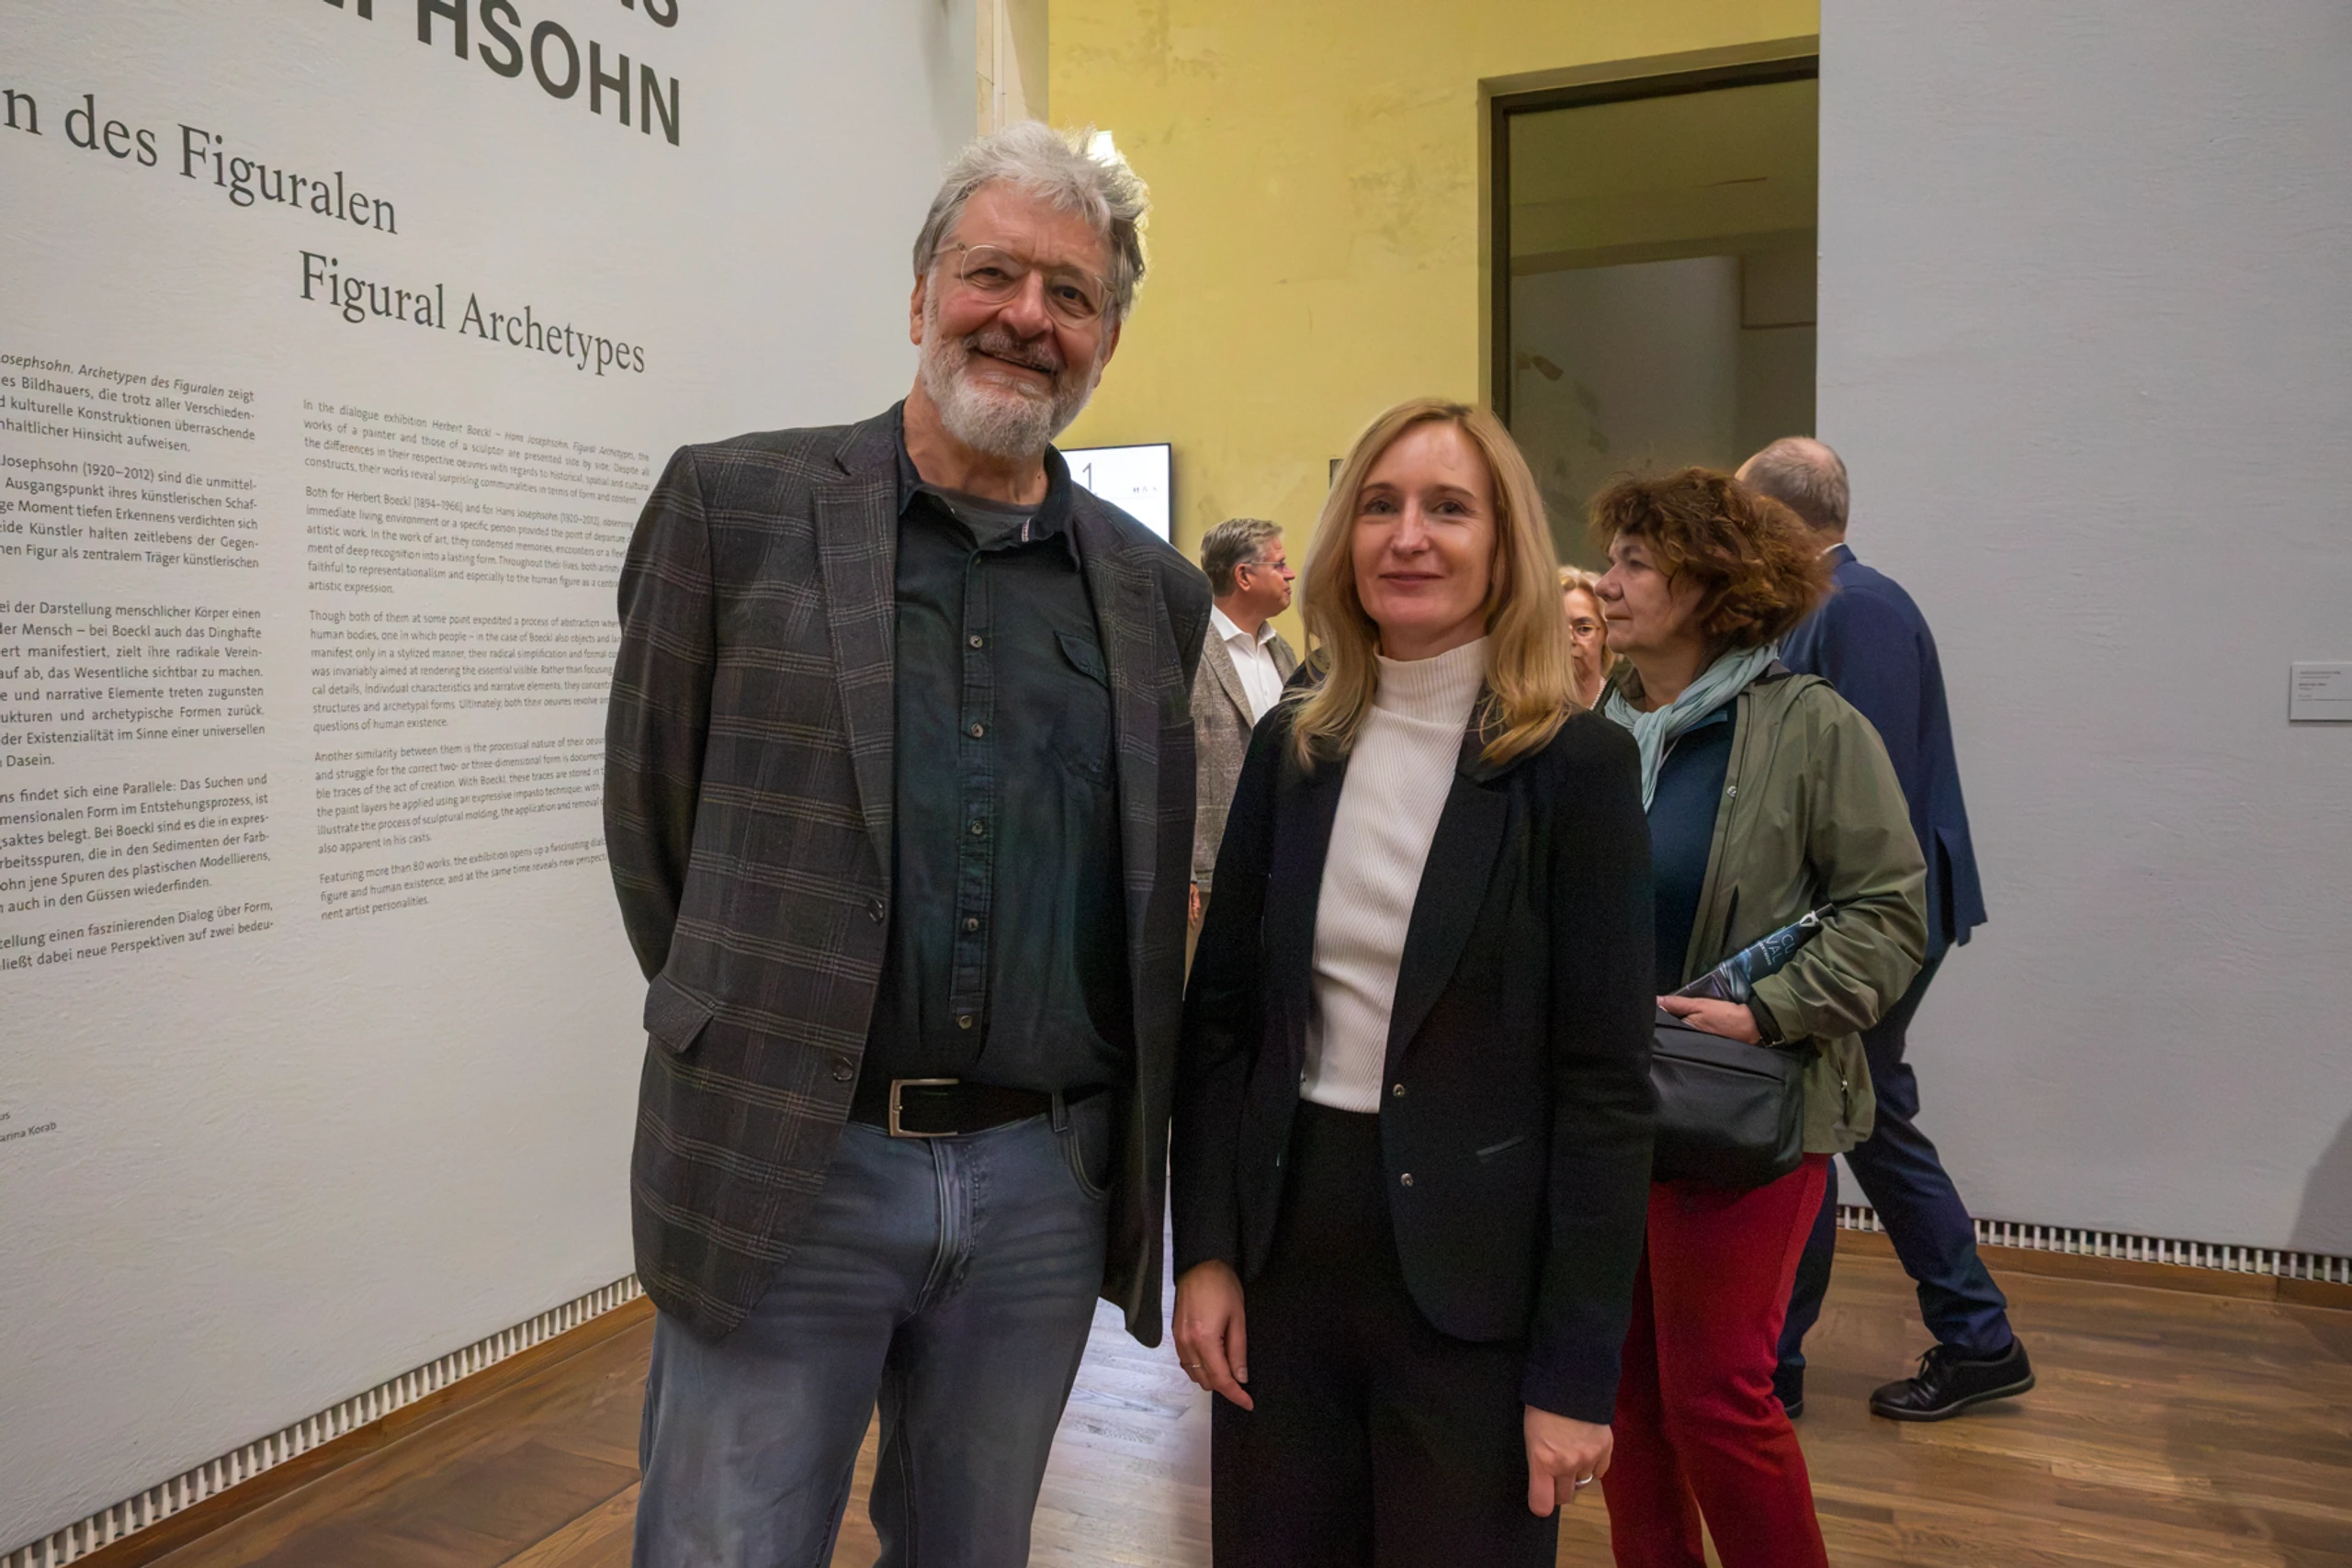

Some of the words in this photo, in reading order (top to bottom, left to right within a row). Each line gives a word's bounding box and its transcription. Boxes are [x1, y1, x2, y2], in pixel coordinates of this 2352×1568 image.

[64, 93, 158, 167] des
[176, 123, 398, 235] Figuralen
[299, 250, 446, 330] Figural
[458, 292, 645, 377] Archetypes
[77, 364, 147, 386] Archetypen
[151, 375, 170, 389] des
[173, 378, 225, 397] Figuralen
[228, 389, 254, 404] zeigt
[97, 388, 118, 402] die
[121, 391, 152, 407] trotz
[154, 397, 182, 411] aller
[10, 395, 74, 417] kulturelle
[77, 406, 171, 430] Konstruktionen
[175, 419, 255, 441] überraschende
[72, 426, 123, 445] Hinsicht
[5, 476, 105, 498] Ausgangspunkt
[108, 485, 138, 501] ihres
[141, 489, 222, 507] künstlerischen
[157, 470, 182, 484] sind
[185, 473, 203, 486] die
[17, 500, 74, 516] Moment
[75, 504, 113, 519] tiefen
[116, 507, 175, 524] Erkennens
[177, 514, 235, 528] verdichten
[237, 518, 258, 530] sich
[0, 519, 24, 535] ide
[29, 522, 84, 538] Künstler
[88, 525, 129, 541] halten
[133, 530, 193, 546] zeitlebens
[197, 534, 216, 547] der
[14, 601, 36, 615] der
[39, 601, 113, 619] Darstellung
[115, 604, 191, 618] menschlicher
[194, 606, 230, 622] Körper
[232, 607, 261, 619] einen
[21, 623, 74, 637] Mensch
[88, 623, 107, 637] bei
[112, 624, 151, 637] Boeckl
[154, 626, 182, 637] auch
[185, 626, 206, 637] das
[209, 626, 262, 642] Dinghafte
[47, 666, 71, 680] das
[74, 665, 149, 679] Wesentliche
[152, 665, 198, 678] sichtbar
[201, 668, 215, 678] zu
[14, 687, 40, 702] und
[46, 687, 103, 701] narrative
[107, 686, 164, 700] Elemente
[168, 687, 204, 698] treten
[208, 685, 264, 701] zugunsten
[60, 708, 85, 722] und
[91, 706, 175, 723] archetypische
[179, 705, 222, 718] Formen
[18, 788, 59, 802] findet
[62, 784, 88, 799] sich
[92, 784, 119, 797] eine
[180, 779, 201, 791] Das
[204, 775, 243, 789] Suchen
[246, 773, 268, 786] und
[0, 832, 44, 851] saktes
[94, 825, 113, 839] Bei
[116, 821, 154, 837] Boeckl
[156, 819, 182, 833] sind
[183, 820, 197, 830] es
[198, 817, 216, 829] die
[218, 816, 229, 827] in
[87, 847, 107, 861] die
[110, 846, 123, 858] in
[126, 843, 149, 856] den
[152, 838, 220, 854] Sedimenten
[222, 834, 241, 847] der
[28, 874, 58, 893] jene
[61, 871, 105, 887] Spuren
[107, 866, 130, 879] des
[132, 859, 197, 880] plastischen
[7, 897, 40, 913] auch
[42, 896, 56, 908] in
[59, 893, 84, 908] den
[85, 888, 130, 903] Güssen
[48, 928, 85, 942] einen
[87, 914, 175, 937] faszinierenden
[177, 908, 214, 924] Dialog
[217, 905, 242, 919] über
[36, 948, 74, 965] dabei
[76, 945, 107, 959] neue
[110, 933, 186, 953] Perspektiven
[187, 927, 208, 942] auf
[209, 923, 235, 939] zwei
